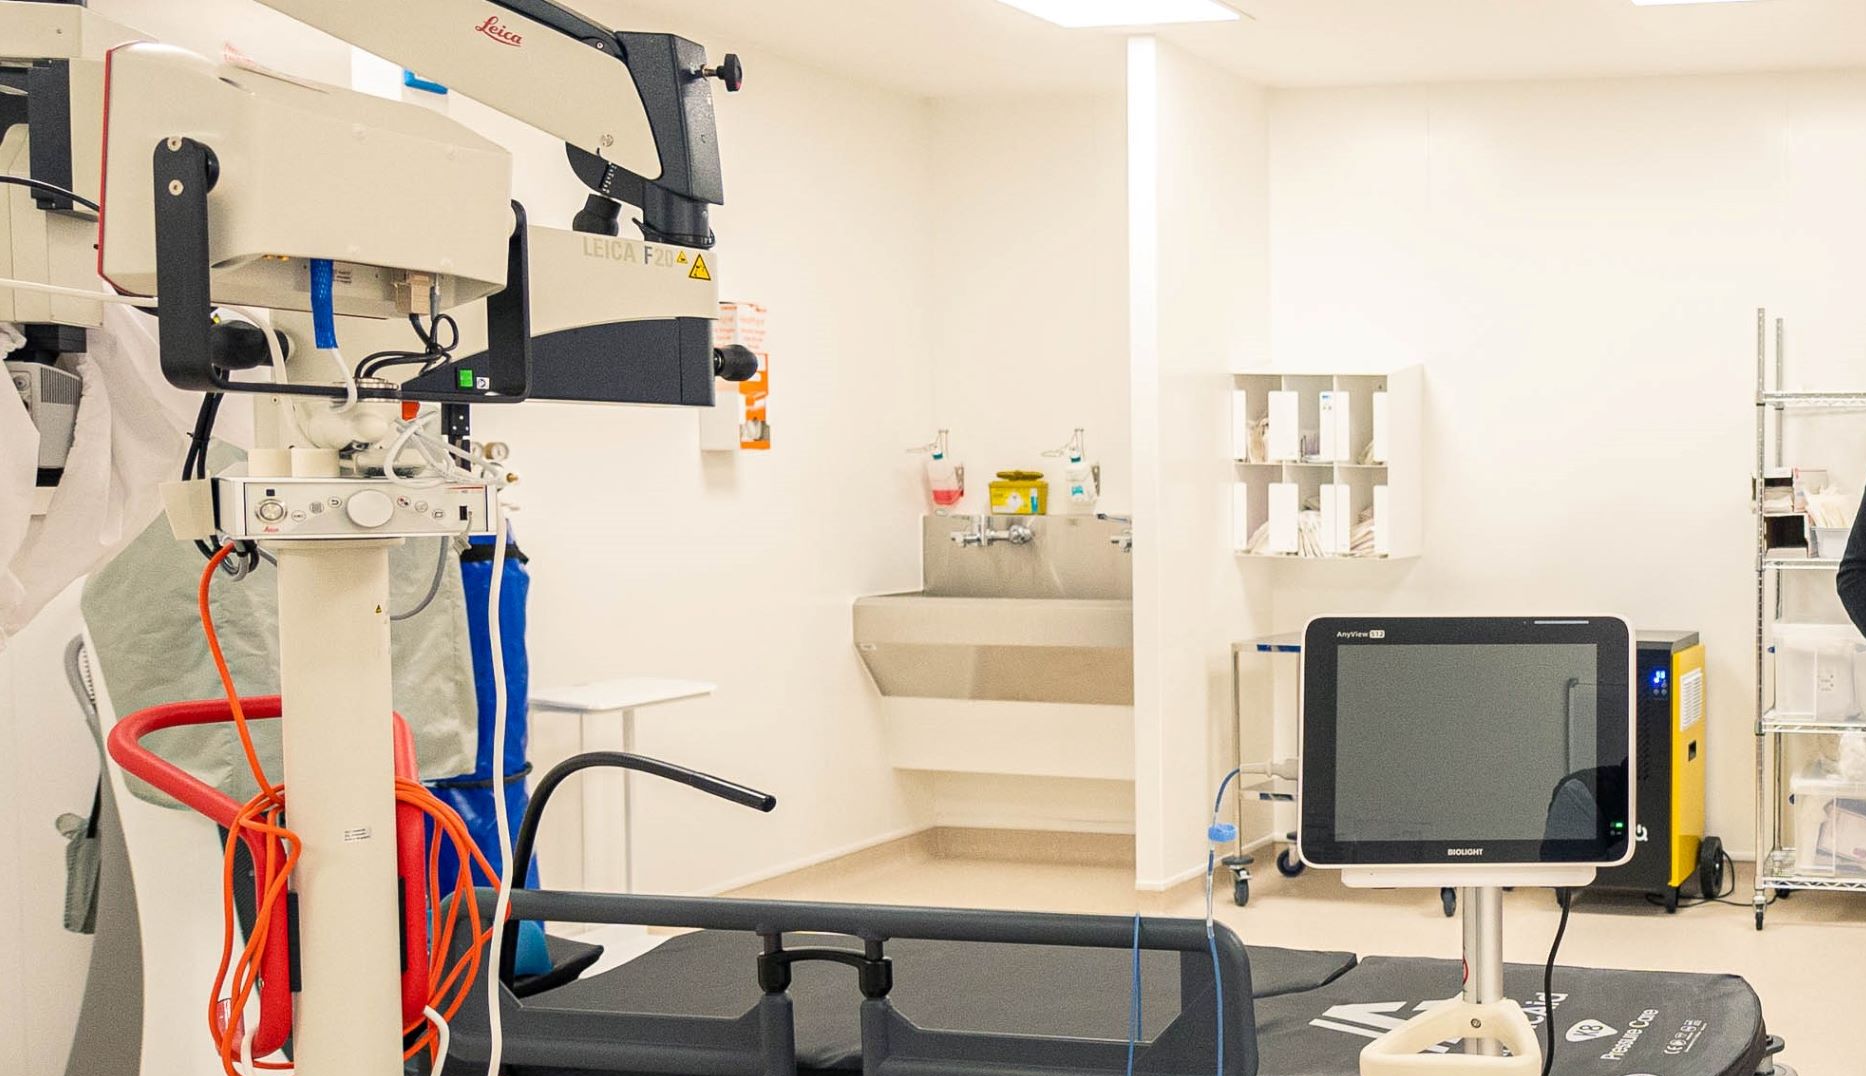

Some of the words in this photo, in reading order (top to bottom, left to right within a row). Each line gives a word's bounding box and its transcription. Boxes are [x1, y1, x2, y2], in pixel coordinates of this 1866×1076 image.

[475, 16, 522, 46] Leica
[583, 236, 636, 262] LEICA
[1336, 631, 1369, 639] AnyView
[1447, 848, 1484, 856] BIOLIGHT
[1573, 1025, 1603, 1037] K8
[1600, 1029, 1642, 1060] Pressure
[1629, 1009, 1659, 1028] Care
